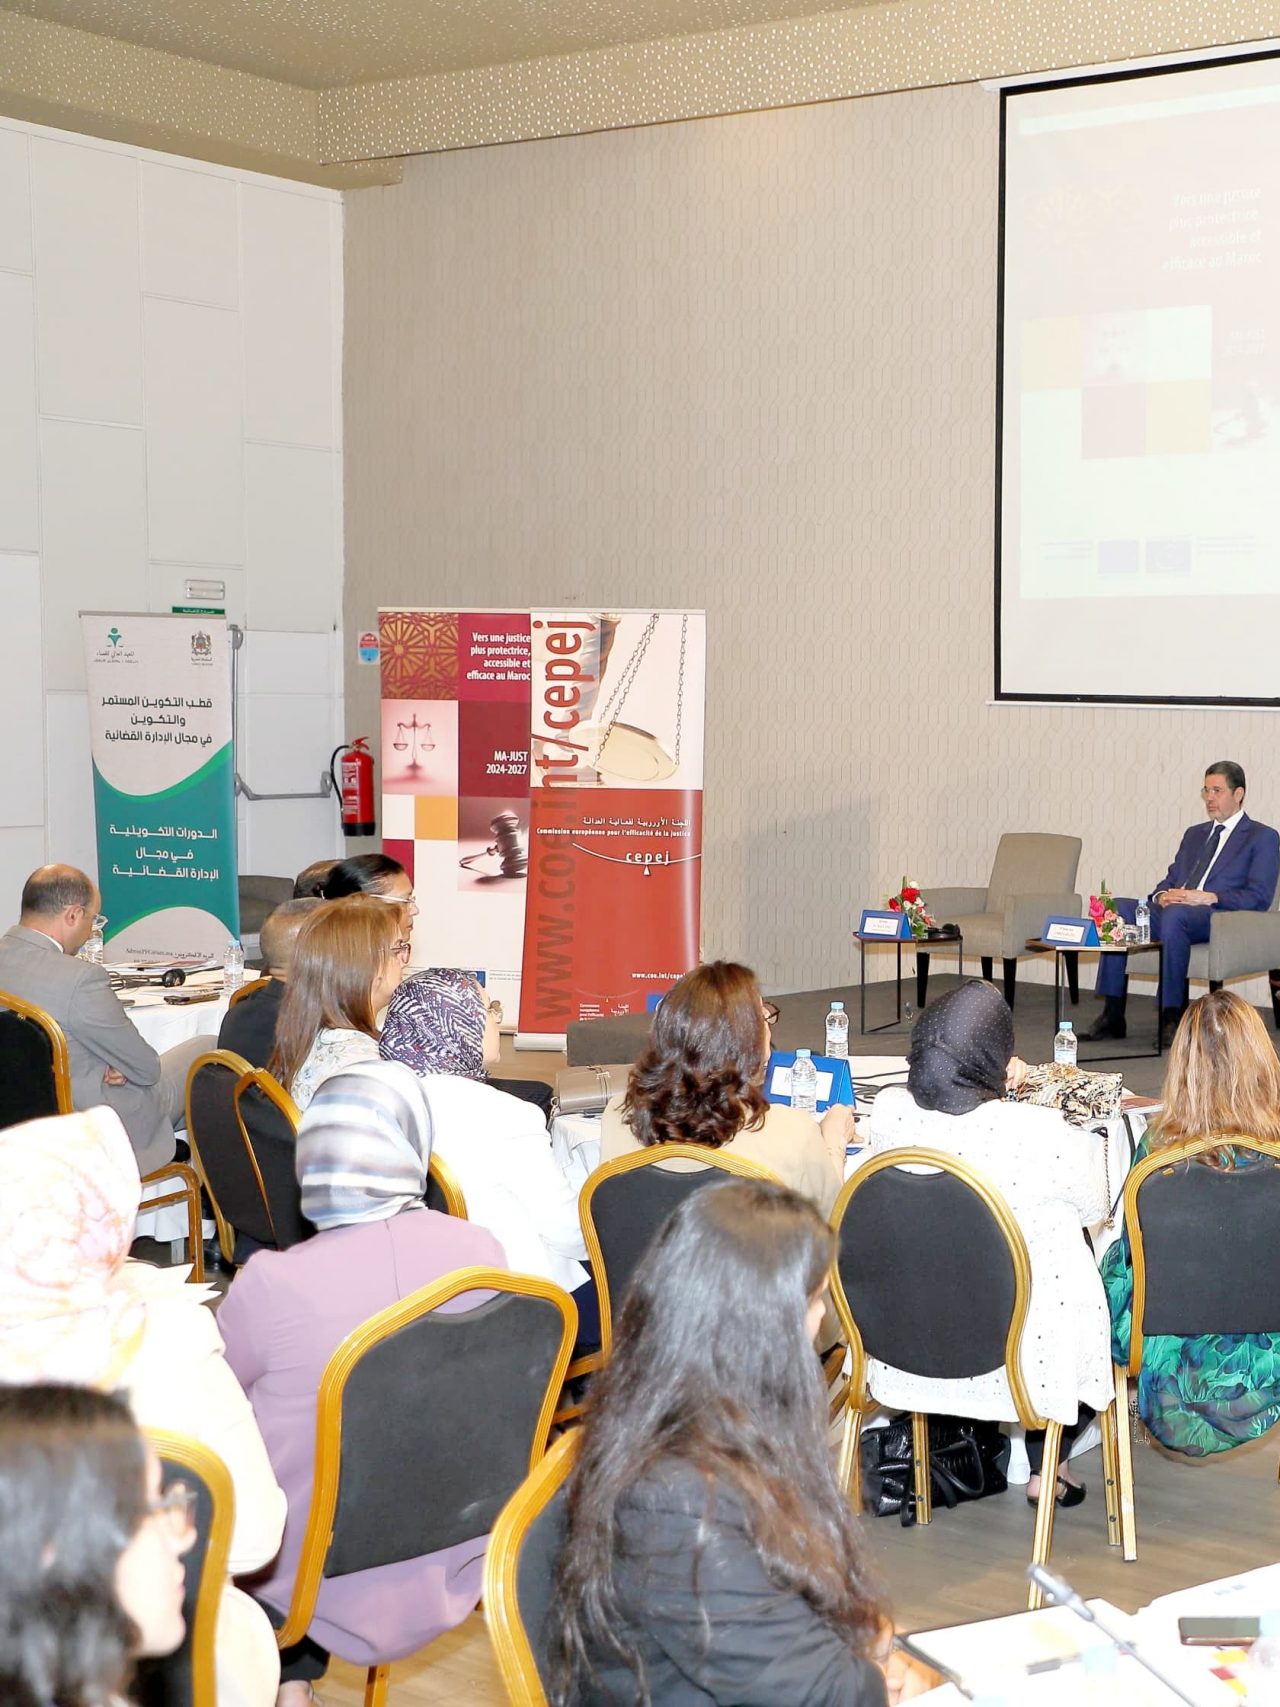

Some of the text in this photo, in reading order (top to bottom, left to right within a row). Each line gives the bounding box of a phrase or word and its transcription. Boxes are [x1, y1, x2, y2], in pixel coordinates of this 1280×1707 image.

[472, 632, 530, 644] Vers une justice
[470, 645, 530, 657] plus protectrice,
[484, 658, 520, 667] accessible
[467, 670, 530, 680] efficace au Maroc
[102, 695, 212, 709] قطب التكوين المستمر
[131, 713, 185, 727] والتكوين
[105, 730, 212, 747] في مجال الإدارة القضائية
[494, 751, 528, 761] MA-JUST
[486, 764, 527, 774] 2024-2027
[583, 817, 605, 825] العدالة
[609, 818, 633, 826] لفعالية
[671, 818, 691, 828] اللجنة
[110, 824, 217, 840] الدورات التكوينية
[536, 827, 570, 835] Commission
[621, 829, 653, 837] l'efficacité
[670, 829, 691, 838] justice
[136, 847, 193, 863] في مجال
[626, 851, 670, 865] cepej
[112, 864, 219, 882] الإدارة القضائية
